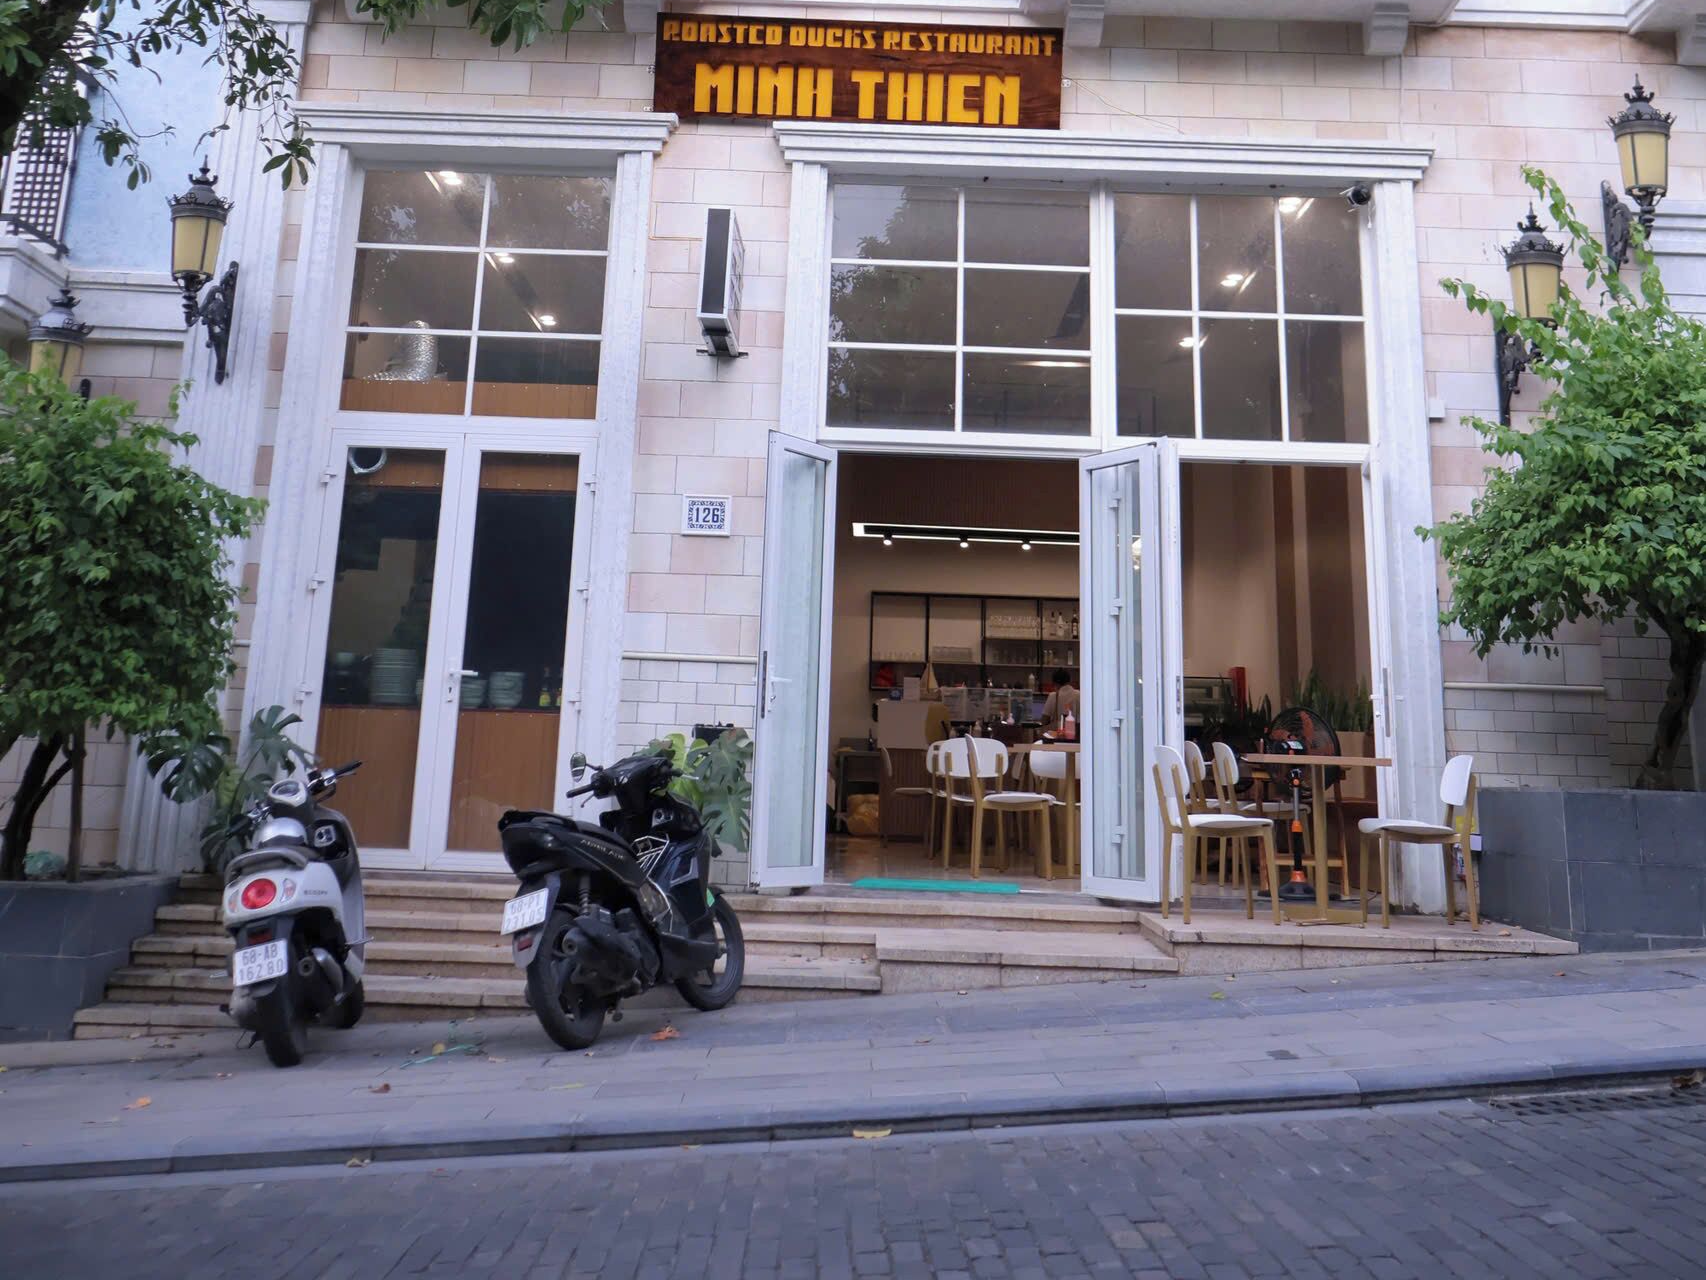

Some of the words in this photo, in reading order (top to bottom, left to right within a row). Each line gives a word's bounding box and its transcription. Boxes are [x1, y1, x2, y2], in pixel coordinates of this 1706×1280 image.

[663, 21, 783, 45] ROASTED
[789, 25, 876, 48] DUCKS
[883, 31, 1056, 56] RESTAURANT
[694, 63, 833, 117] MINH
[851, 71, 1020, 125] THIEN
[695, 507, 720, 523] 126
